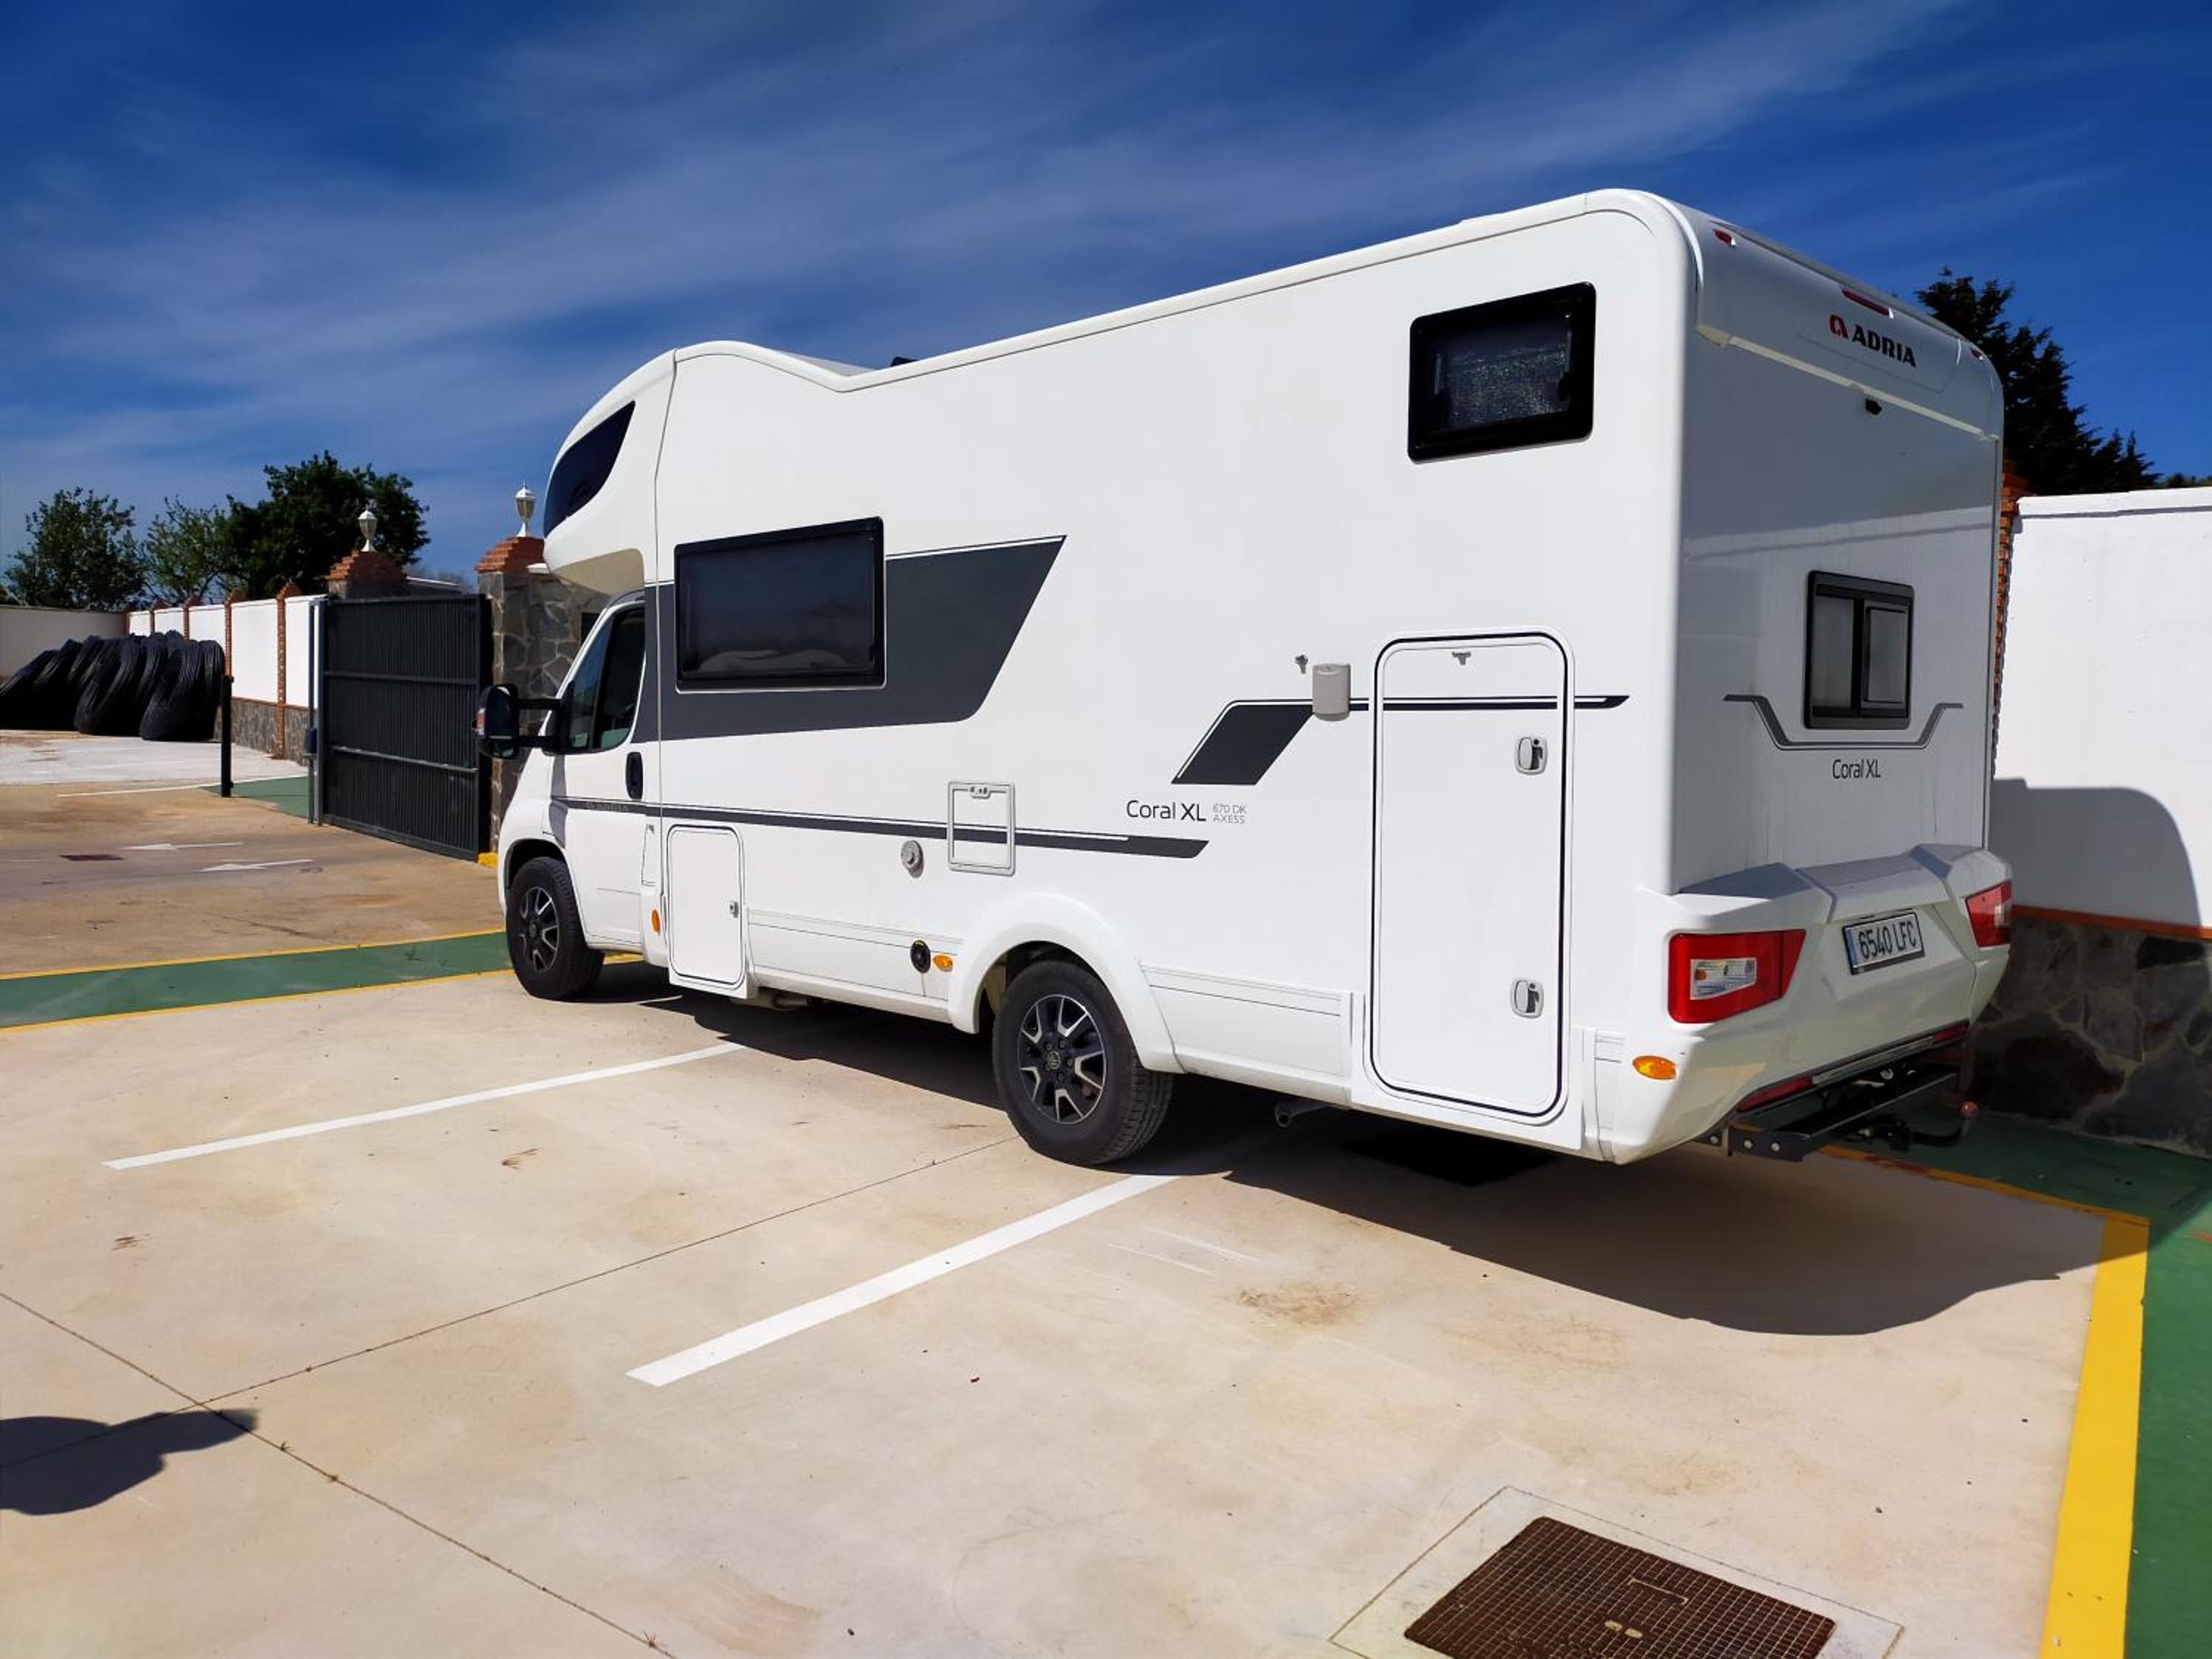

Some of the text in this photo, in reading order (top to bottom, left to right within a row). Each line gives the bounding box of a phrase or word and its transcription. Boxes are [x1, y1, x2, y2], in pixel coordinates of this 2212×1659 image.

[1851, 324, 1916, 368] ADRIA
[1832, 759, 1881, 779] Coral XL
[1126, 799, 1207, 821] Coral XL
[1213, 804, 1247, 814] 670 DK
[1213, 814, 1246, 824] AXESS
[1858, 921, 1916, 959] 6540 LFC
